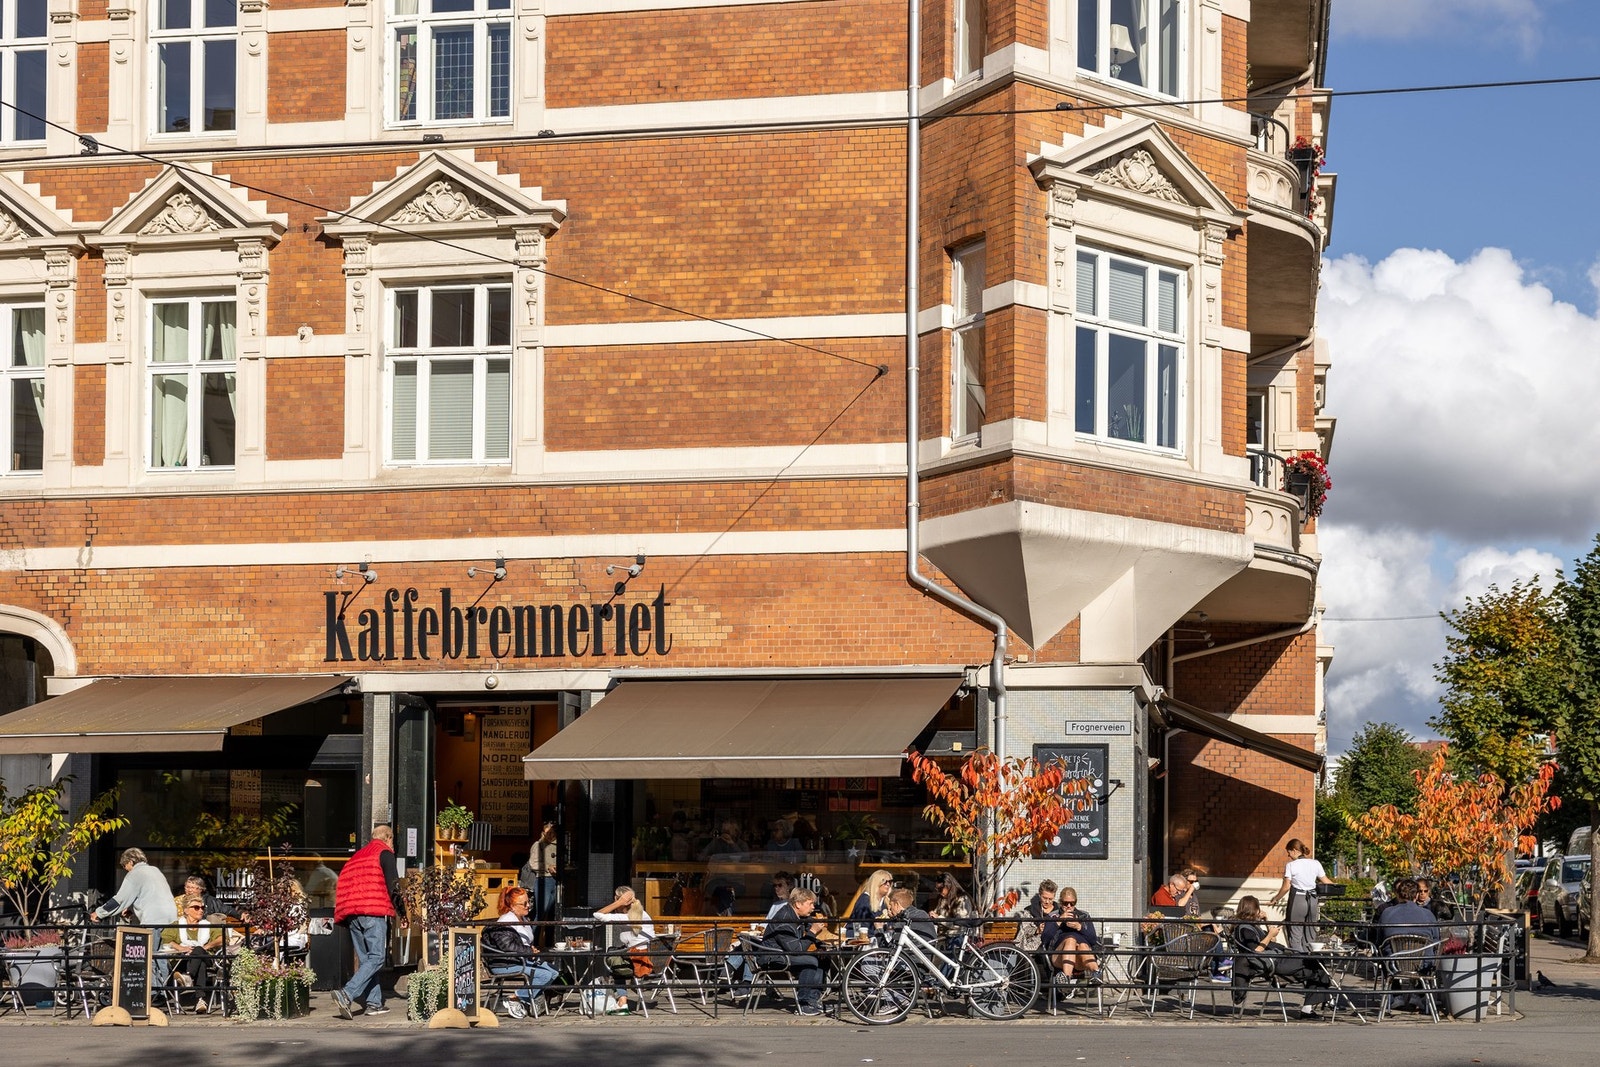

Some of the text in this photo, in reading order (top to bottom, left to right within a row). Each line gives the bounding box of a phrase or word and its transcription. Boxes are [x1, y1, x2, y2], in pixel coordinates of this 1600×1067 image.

[324, 583, 672, 662] Kaffebrenneriet
[1071, 723, 1125, 732] Frognerveien
[483, 730, 530, 739] MANGLERUD
[482, 754, 523, 763] NORDL
[216, 867, 255, 888] Kaffe
